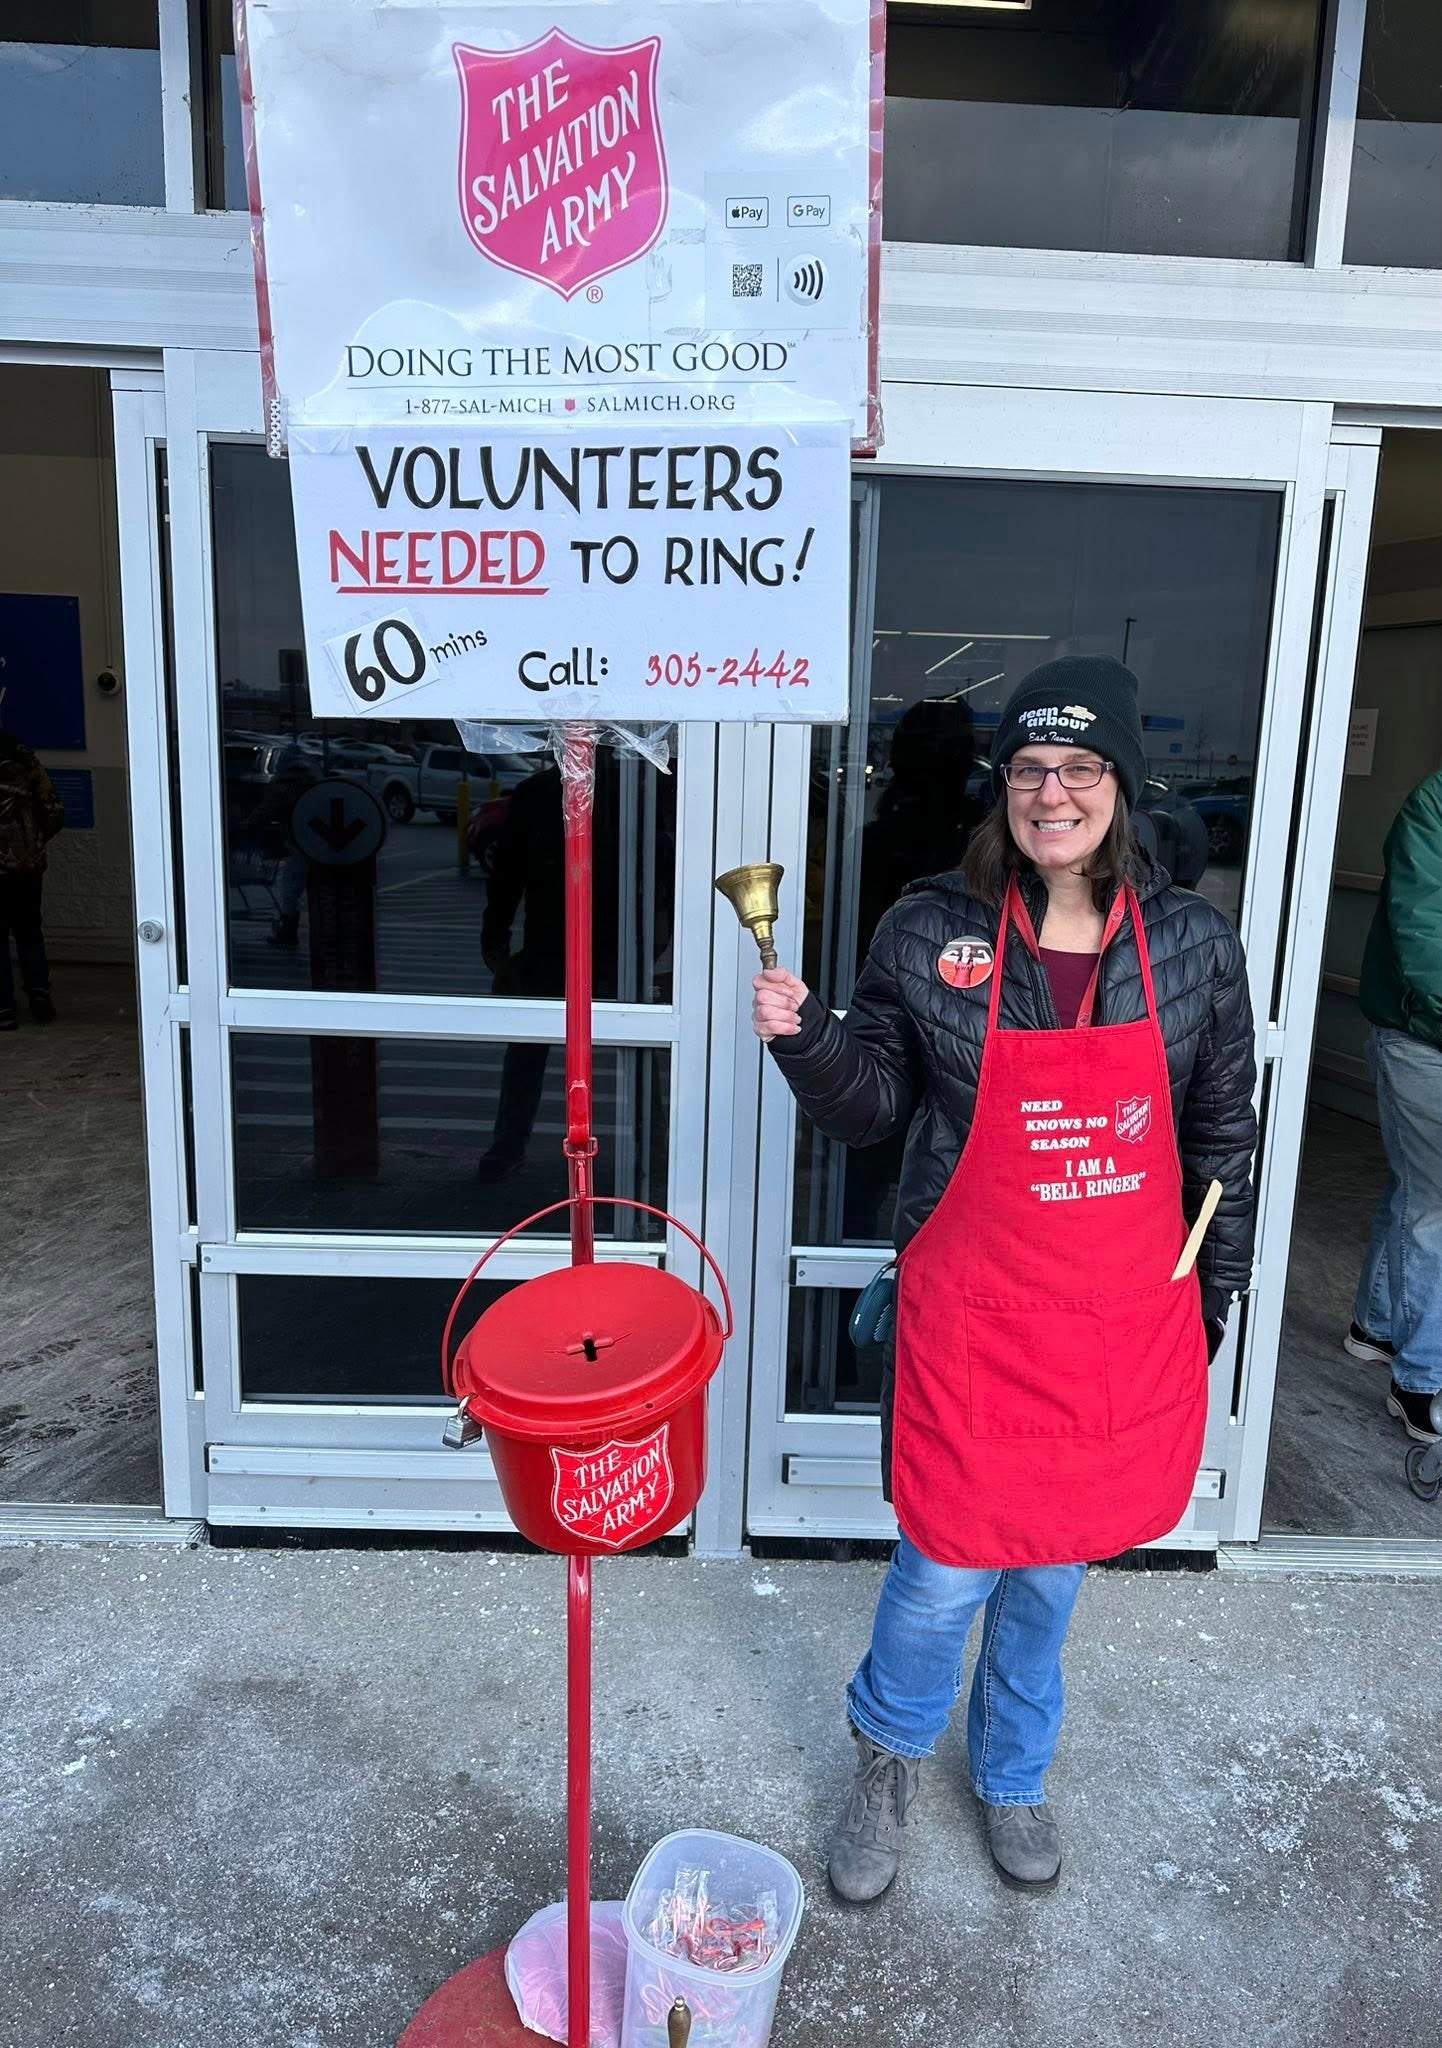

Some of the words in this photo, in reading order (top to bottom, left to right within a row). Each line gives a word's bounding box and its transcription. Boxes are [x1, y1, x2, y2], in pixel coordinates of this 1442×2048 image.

[492, 58, 569, 144] THE
[472, 69, 640, 234] SALVATION
[540, 151, 636, 264] ARMY
[741, 206, 763, 221] Pay
[806, 204, 825, 219] Pay
[345, 345, 472, 378] DOING
[482, 347, 550, 376] THE
[562, 343, 662, 374] MOST
[672, 342, 788, 372] GOOD
[405, 398, 552, 415] 1-877-SAL-MICH
[587, 394, 735, 412] SALMICH.ORG
[355, 445, 783, 512] VOLUNTEERS
[328, 529, 547, 586] NEEDED
[570, 535, 639, 584] TO
[664, 527, 815, 586] RING!
[344, 619, 426, 702] 60
[430, 630, 488, 663] mins
[518, 647, 608, 692] Call:
[645, 647, 810, 688] 305-2442
[1019, 707, 1058, 723] dean
[1027, 713, 1089, 731] arbour
[1020, 1100, 1063, 1112] NEED
[1122, 1101, 1137, 1117] THE
[1025, 1118, 1082, 1132] KNOWS
[1085, 1117, 1108, 1129] NO
[1128, 1114, 1147, 1138] ARMY
[1030, 1136, 1090, 1151] SEASON
[1065, 1160, 1073, 1177] I
[1077, 1158, 1101, 1176] AM
[1105, 1156, 1116, 1174] A
[574, 1449, 621, 1488] THE
[563, 1439, 660, 1523] SALVATION
[602, 1472, 659, 1536] ARMY
